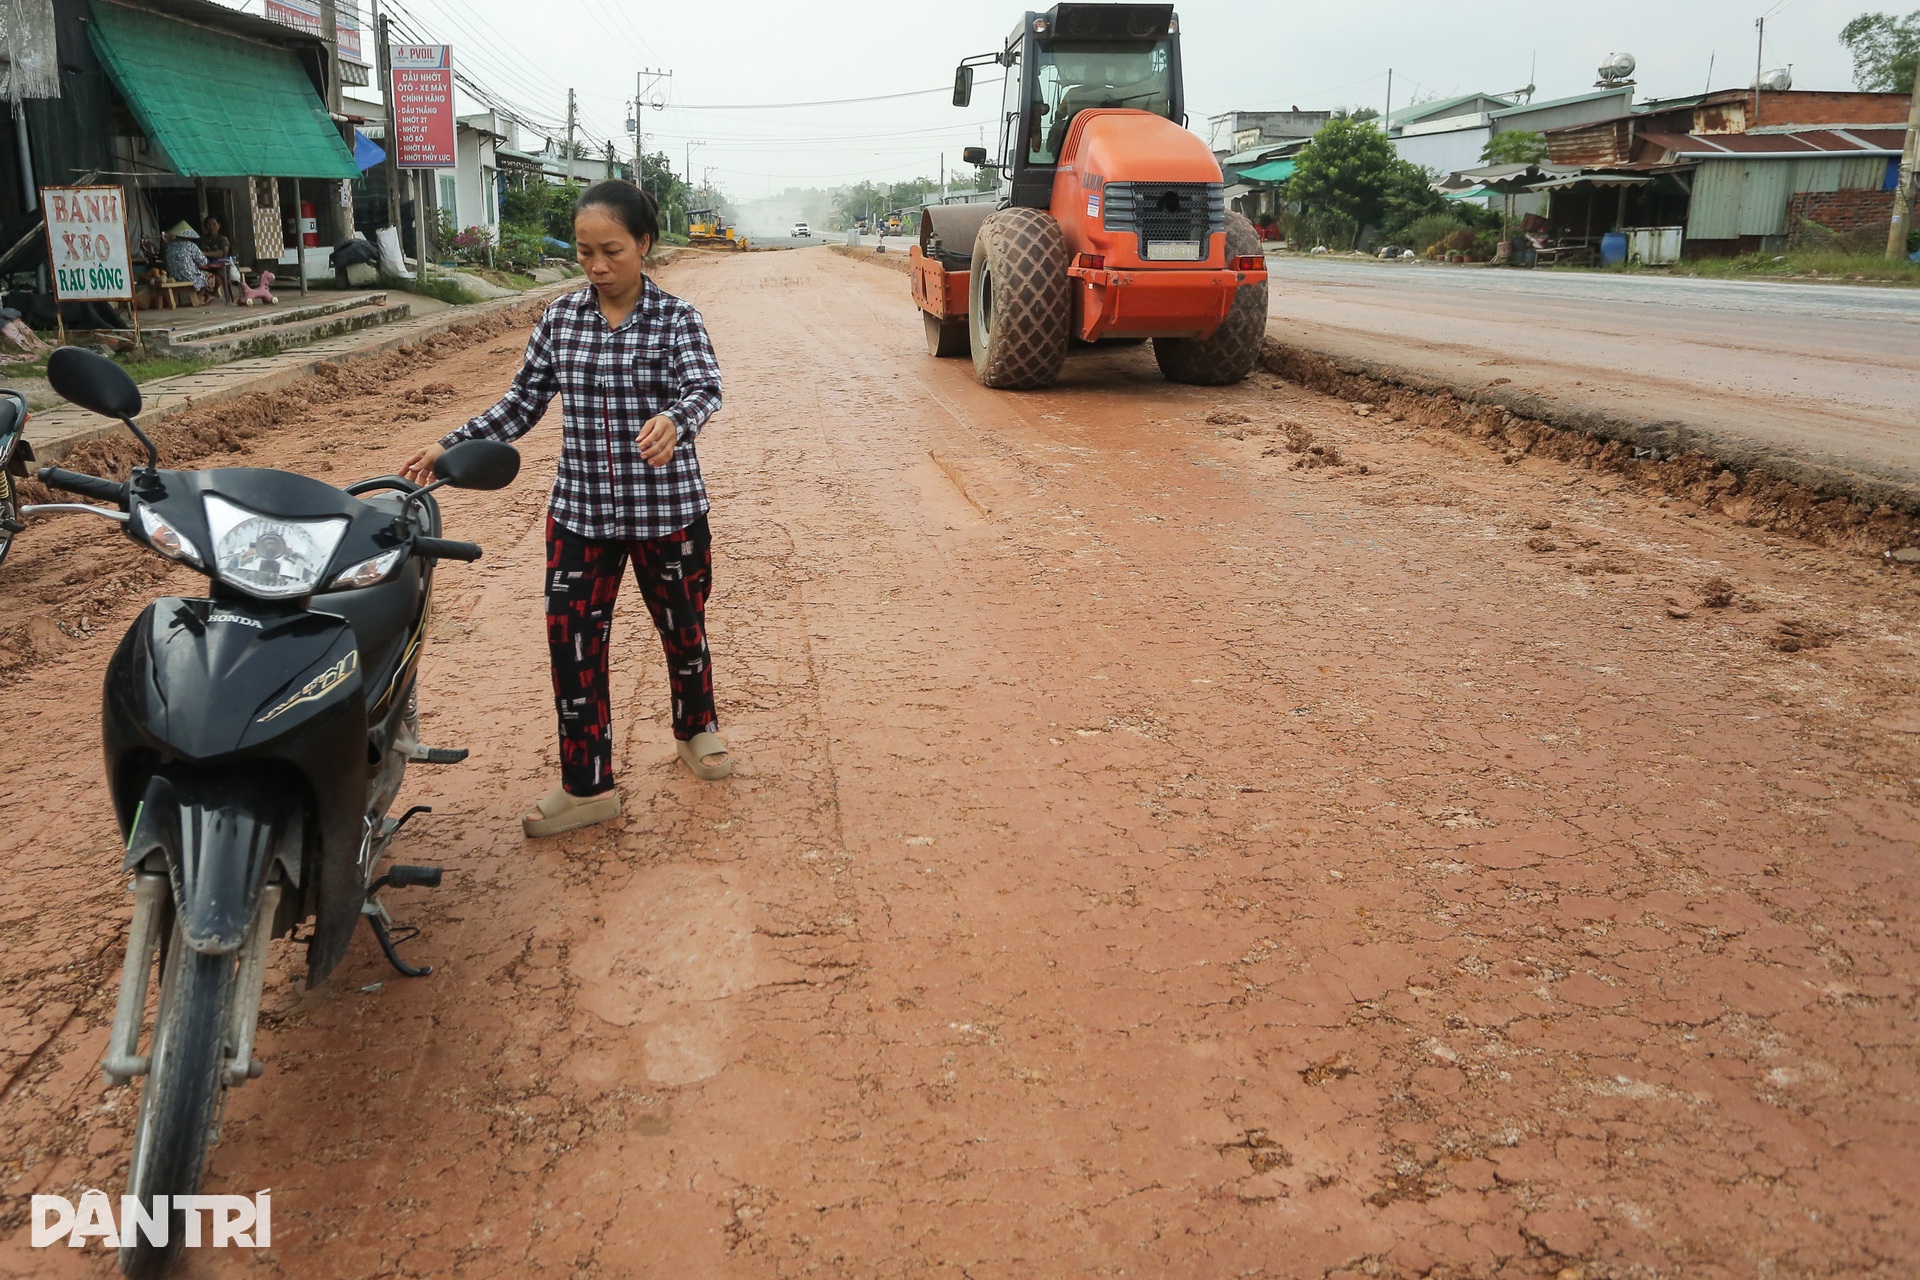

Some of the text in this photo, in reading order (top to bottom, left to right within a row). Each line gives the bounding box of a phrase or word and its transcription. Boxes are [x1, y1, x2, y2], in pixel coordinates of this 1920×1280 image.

[410, 48, 435, 60] PVOIL
[402, 70, 441, 82] DẦU NHỚT
[397, 83, 413, 92] ÔTÔ
[419, 84, 429, 92] XE
[430, 83, 448, 92] MÁY
[400, 93, 446, 103] CHÍNH HÃNG
[401, 115, 427, 124] NHỚT 2T
[402, 124, 428, 133] NHỚT 4T
[403, 143, 436, 152] NHỚT MÁY
[403, 152, 421, 161] NHỚT
[52, 190, 118, 224] BÁNH
[61, 226, 111, 261] XÈO
[58, 262, 124, 291] RAU SÔNG
[207, 614, 263, 629] HONDA
